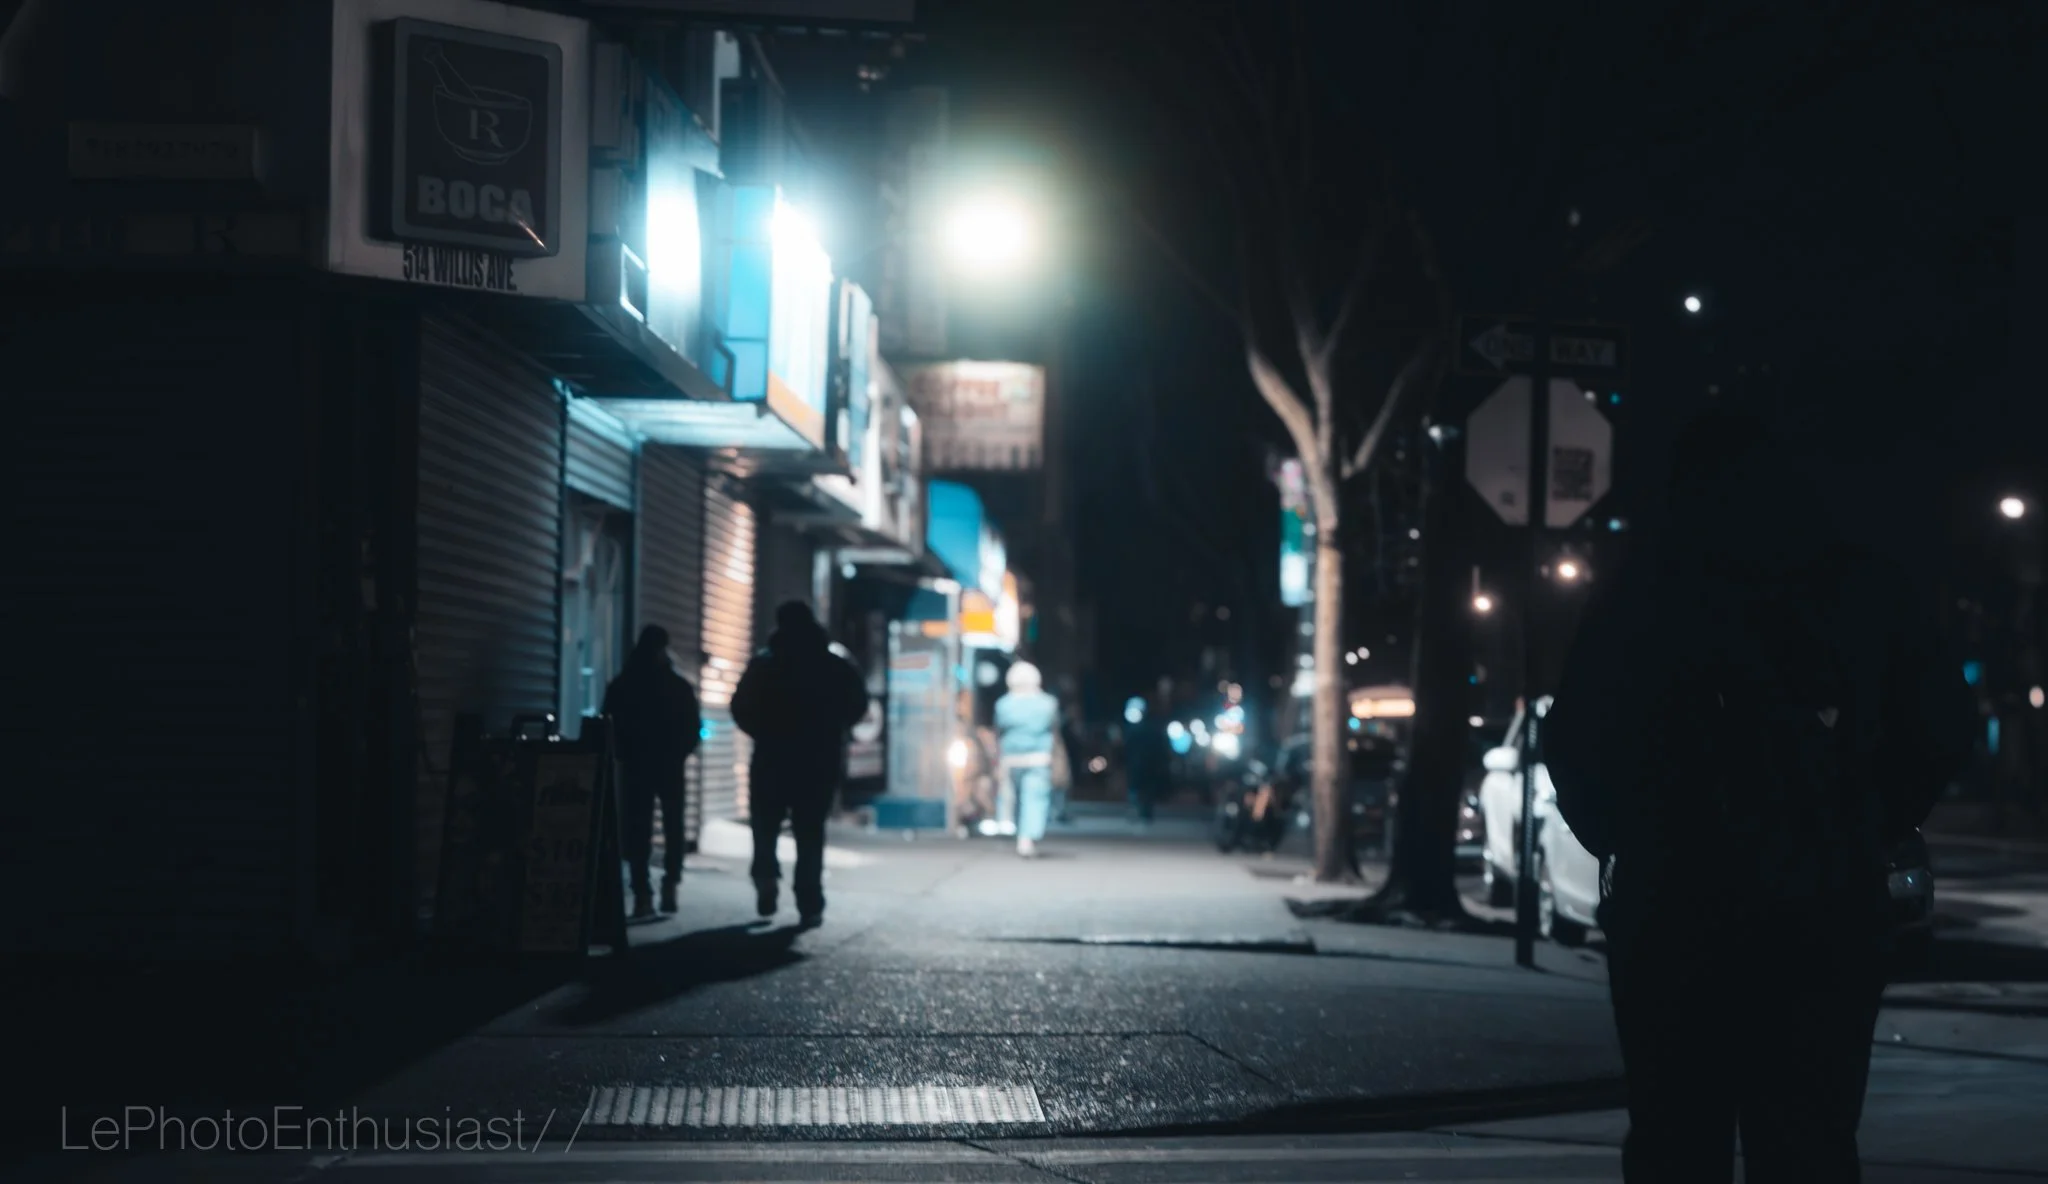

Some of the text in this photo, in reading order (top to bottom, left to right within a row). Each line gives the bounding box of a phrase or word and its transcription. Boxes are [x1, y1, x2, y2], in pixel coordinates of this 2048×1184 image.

[417, 175, 536, 228] BOCA
[403, 245, 429, 281] 514
[434, 247, 484, 288] WILLIS
[1555, 339, 1604, 361] WAY
